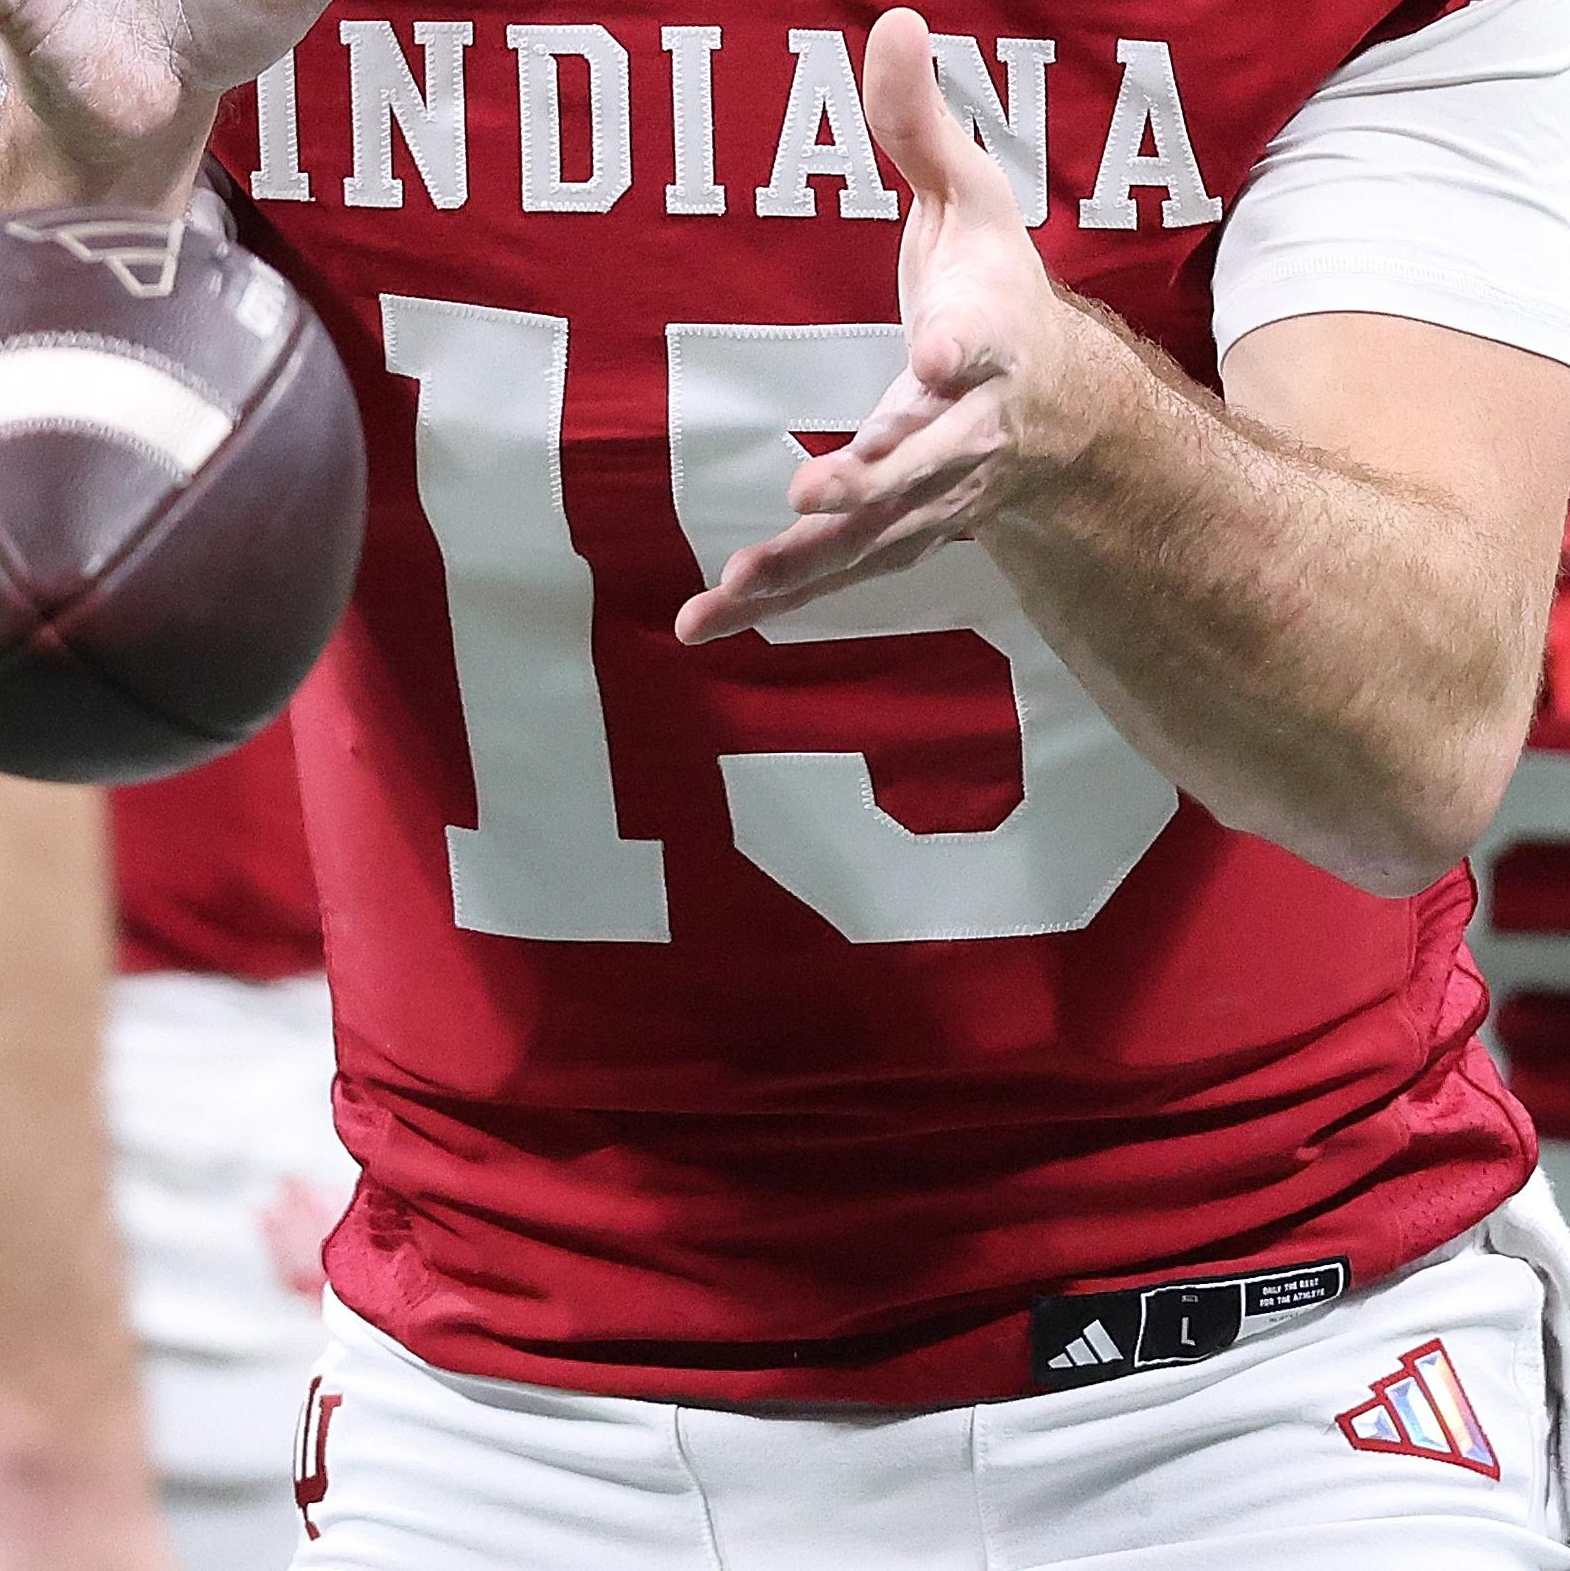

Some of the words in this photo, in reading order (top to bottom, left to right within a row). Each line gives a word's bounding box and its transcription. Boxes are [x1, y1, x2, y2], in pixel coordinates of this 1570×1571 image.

[251, 19, 1223, 231] INDIANA
[379, 292, 1182, 944] 15
[1180, 1316, 1196, 1347] L
